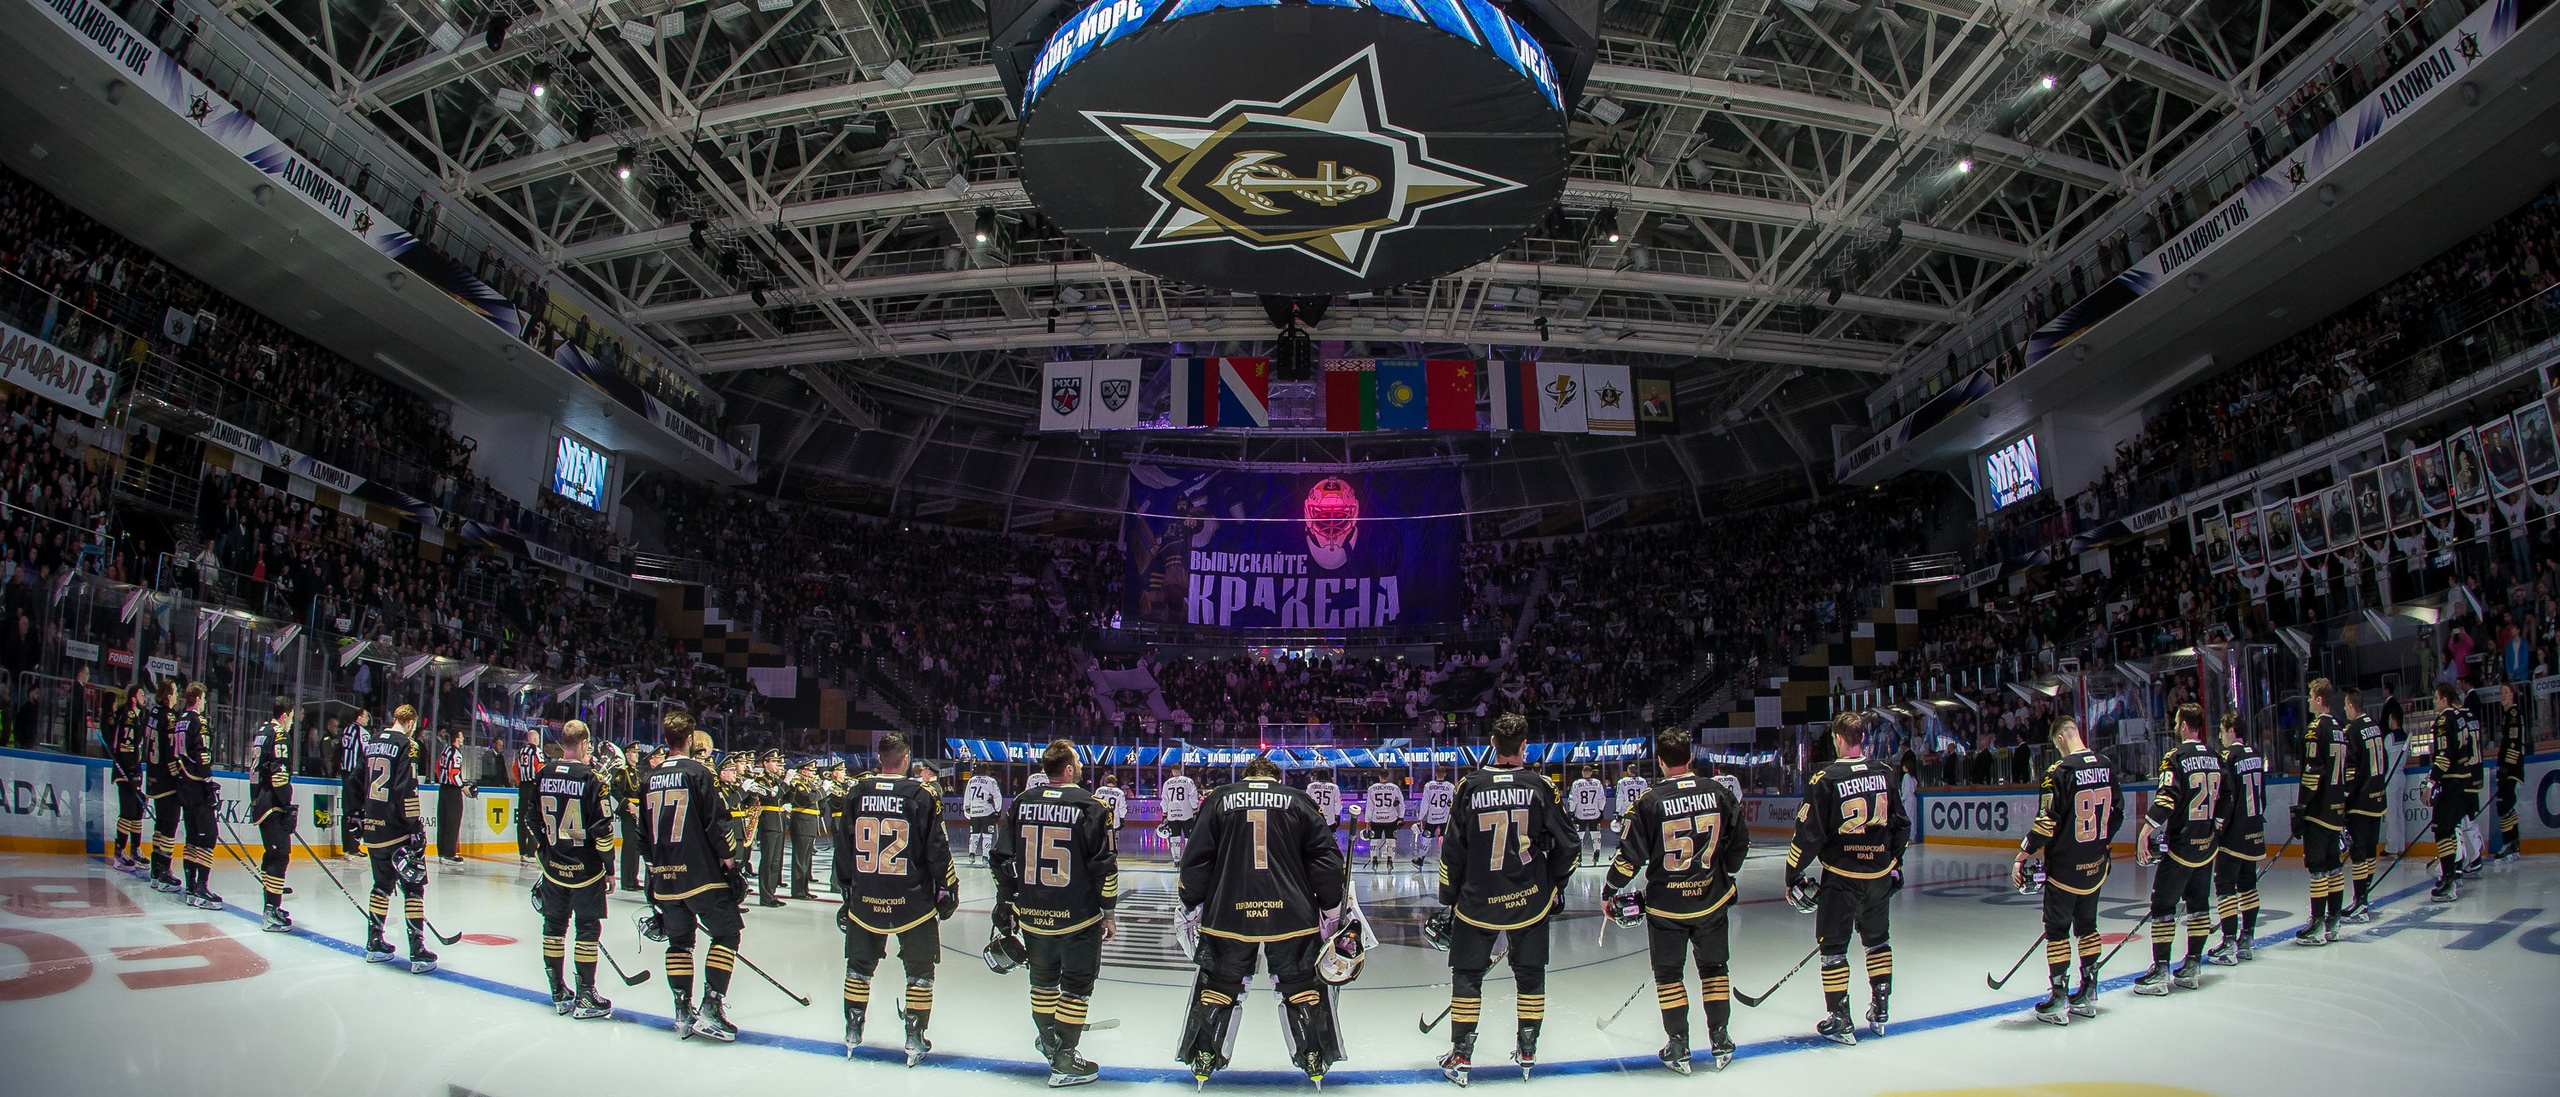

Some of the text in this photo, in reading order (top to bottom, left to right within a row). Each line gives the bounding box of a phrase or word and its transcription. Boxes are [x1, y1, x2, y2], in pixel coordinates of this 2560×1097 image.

[1077, 0, 1143, 48] МОРЕ
[2379, 46, 2457, 119] АДМИРАЛ
[281, 156, 352, 219] АДМИРАЛ
[2158, 197, 2250, 275] ВЛАДИВОСТОК
[1054, 378, 1080, 387] МХЛ
[1850, 440, 1881, 471] АДМИРАЛ
[308, 463, 351, 494] АДМИРАЛ
[2132, 504, 2167, 530] АДМИРАЛ
[1190, 551, 1308, 574] ВЫПУСКАЙТЕ
[1184, 575, 1401, 628] КРАКЕНА
[109, 653, 134, 664] FONBE
[274, 743, 288, 758] 62
[1404, 752, 1429, 763] НАШЕ
[1432, 752, 1456, 761] МОРЕ
[2181, 756, 2220, 773] SHEVCHENK
[366, 757, 392, 802] 12
[650, 773, 682, 790] GRMAN
[1836, 775, 1887, 799] DERYABIN
[971, 786, 984, 801] 74
[1168, 787, 1185, 802] 78
[1222, 791, 1292, 812] MISHUROV
[1314, 791, 1331, 806] 35
[1375, 793, 1392, 807] 55
[1430, 793, 1447, 808] 48
[1471, 788, 1535, 810] MURANOV
[1580, 790, 1597, 804] 87
[1628, 788, 1641, 802] 81
[861, 796, 904, 815] PRINCE
[1018, 803, 1080, 825] PETUKHOV
[1662, 792, 1717, 817] RUCHKIN
[1838, 792, 1888, 835] 24
[2074, 786, 2112, 843] 87
[541, 796, 587, 846] 64
[646, 788, 689, 844] 77
[1931, 801, 2009, 831] согаз
[855, 817, 909, 876] 92
[1246, 809, 1268, 870] 1
[1478, 808, 1532, 871] 71
[1662, 812, 1721, 872] 57
[1843, 844, 1885, 854] ПРИМОРСКИЙ
[1021, 825, 1072, 887] 15
[1857, 853, 1874, 861] КРАЙ
[862, 896, 906, 906] ПРИМОРСКИЙ
[1487, 885, 1539, 905] ПРИМОРСКИЙ
[1682, 888, 1703, 897] КРАЙ
[873, 905, 893, 914] КРАЙ
[1020, 907, 1071, 918] ПРИМОРСКИЙ
[1235, 900, 1284, 911] ПРИМОРСКИЙ
[1504, 898, 1528, 909] КРАЙ
[1033, 917, 1055, 926] КРАЙ
[1246, 910, 1269, 918] КРАЙ
